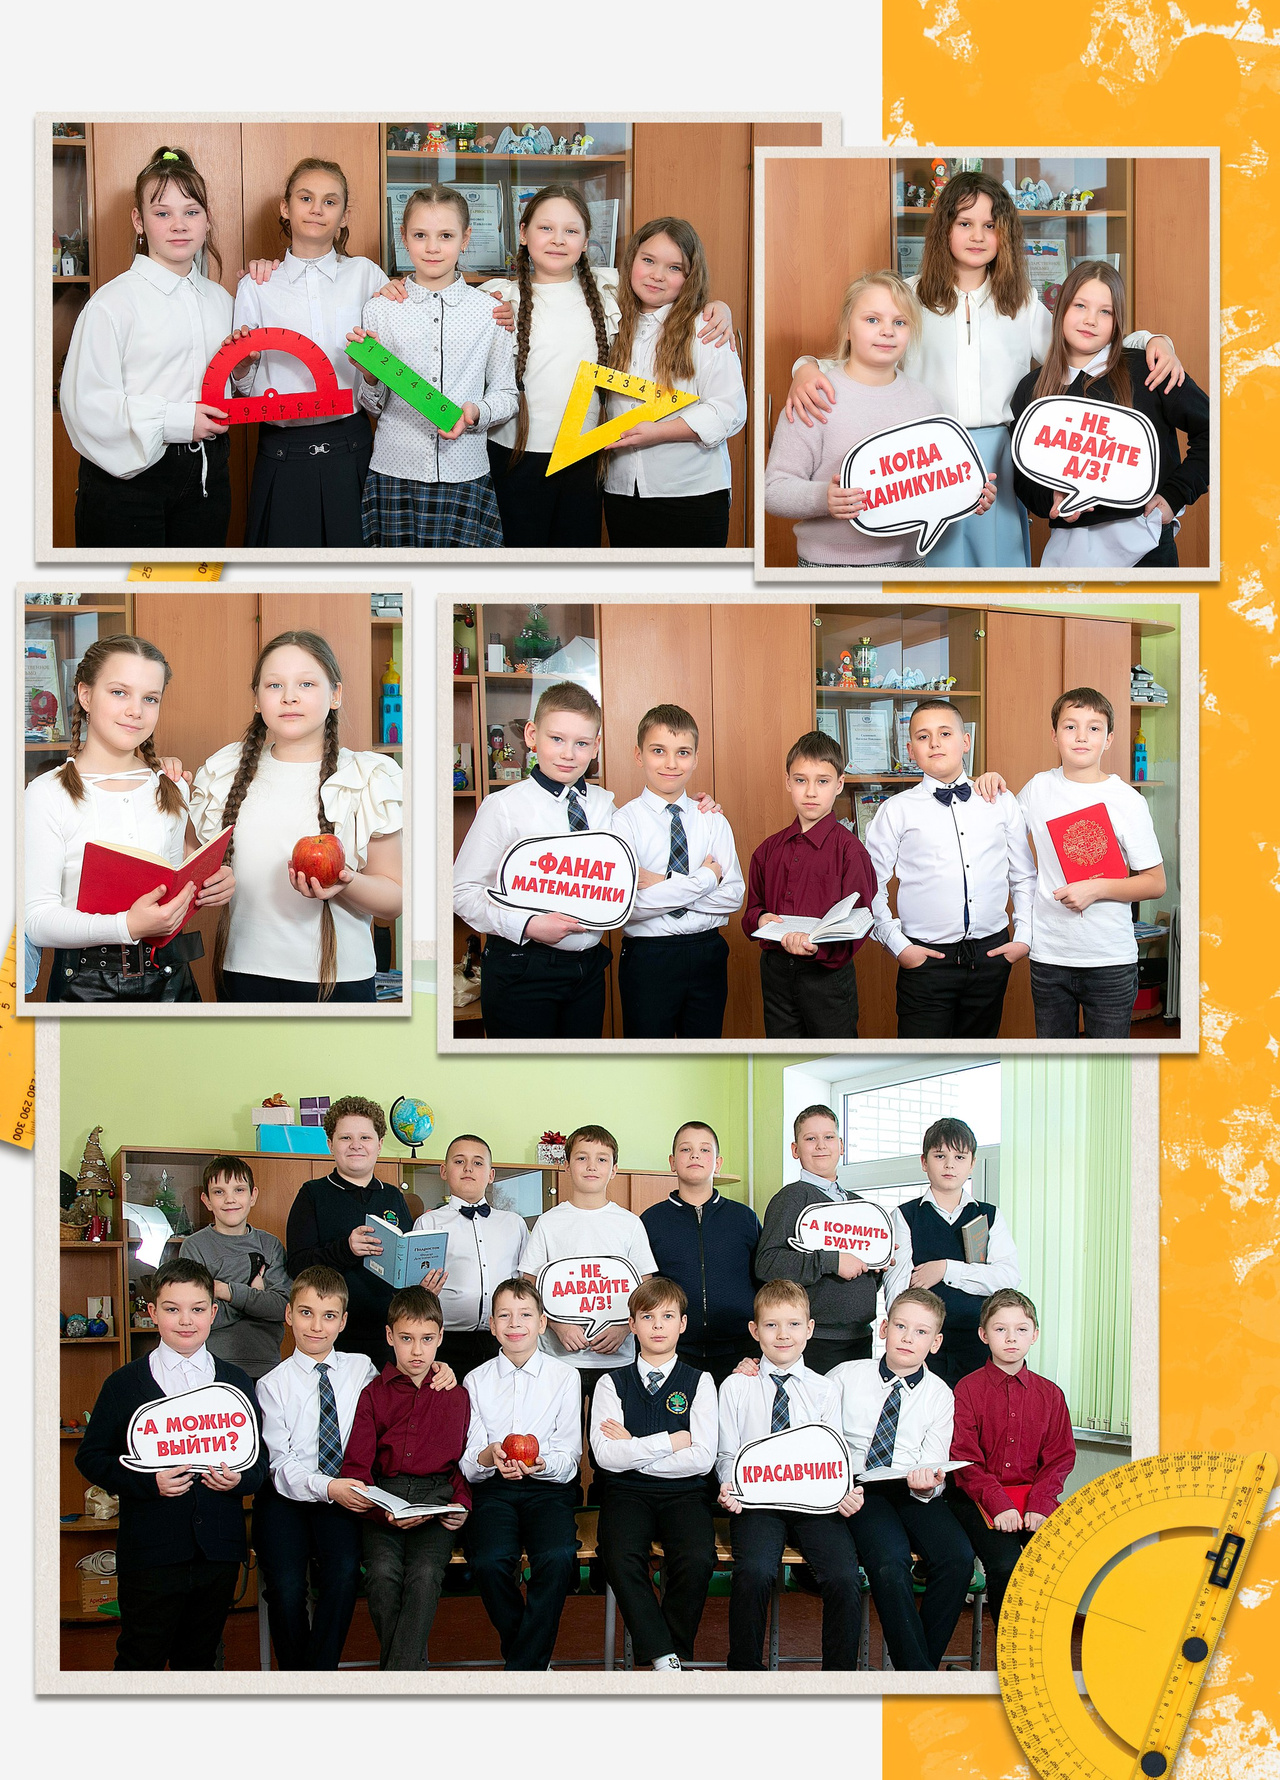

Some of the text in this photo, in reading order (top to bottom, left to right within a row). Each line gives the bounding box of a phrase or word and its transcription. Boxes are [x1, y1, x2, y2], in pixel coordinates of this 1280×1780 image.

[367, 345, 448, 413] 1 2 3 4 5 6
[593, 370, 678, 403] 1 2 3 4 5 6
[243, 407, 250, 416] 6
[261, 405, 268, 415] 5
[279, 404, 286, 412] 4
[296, 402, 304, 411] 3
[315, 401, 321, 410] 2
[330, 400, 336, 408] 1
[1080, 411, 1111, 435] НЕ
[1034, 425, 1141, 467] ДАВАЙТЕ
[879, 443, 943, 478] КОГДА
[1062, 456, 1111, 483] Д/З!
[860, 461, 972, 512] КАНИКУЛЫ?
[142, 566, 153, 579] 25
[529, 852, 616, 881] -ФАНАТ
[511, 875, 625, 903] МАТЕМАТИКИ
[20, 1100, 32, 1120] 290
[13, 1121, 26, 1141] 300
[824, 1220, 889, 1240] КОРМИТЬ
[824, 1235, 871, 1251] БУДУТ?
[581, 1264, 601, 1278] НЕ
[552, 1276, 630, 1297] ДАВАЙТЕ
[579, 1295, 612, 1313] Д/З!
[166, 1412, 247, 1433] МОЖНО
[156, 1431, 239, 1457] ВЫЙТИ?
[742, 1461, 843, 1483] КРАСАВЧИК!
[1172, 1675, 1179, 1683] 10
[1227, 1524, 1234, 1532] 22
[1232, 1512, 1238, 1520] 23
[1236, 1499, 1243, 1507] 24
[1241, 1486, 1248, 1494] 25
